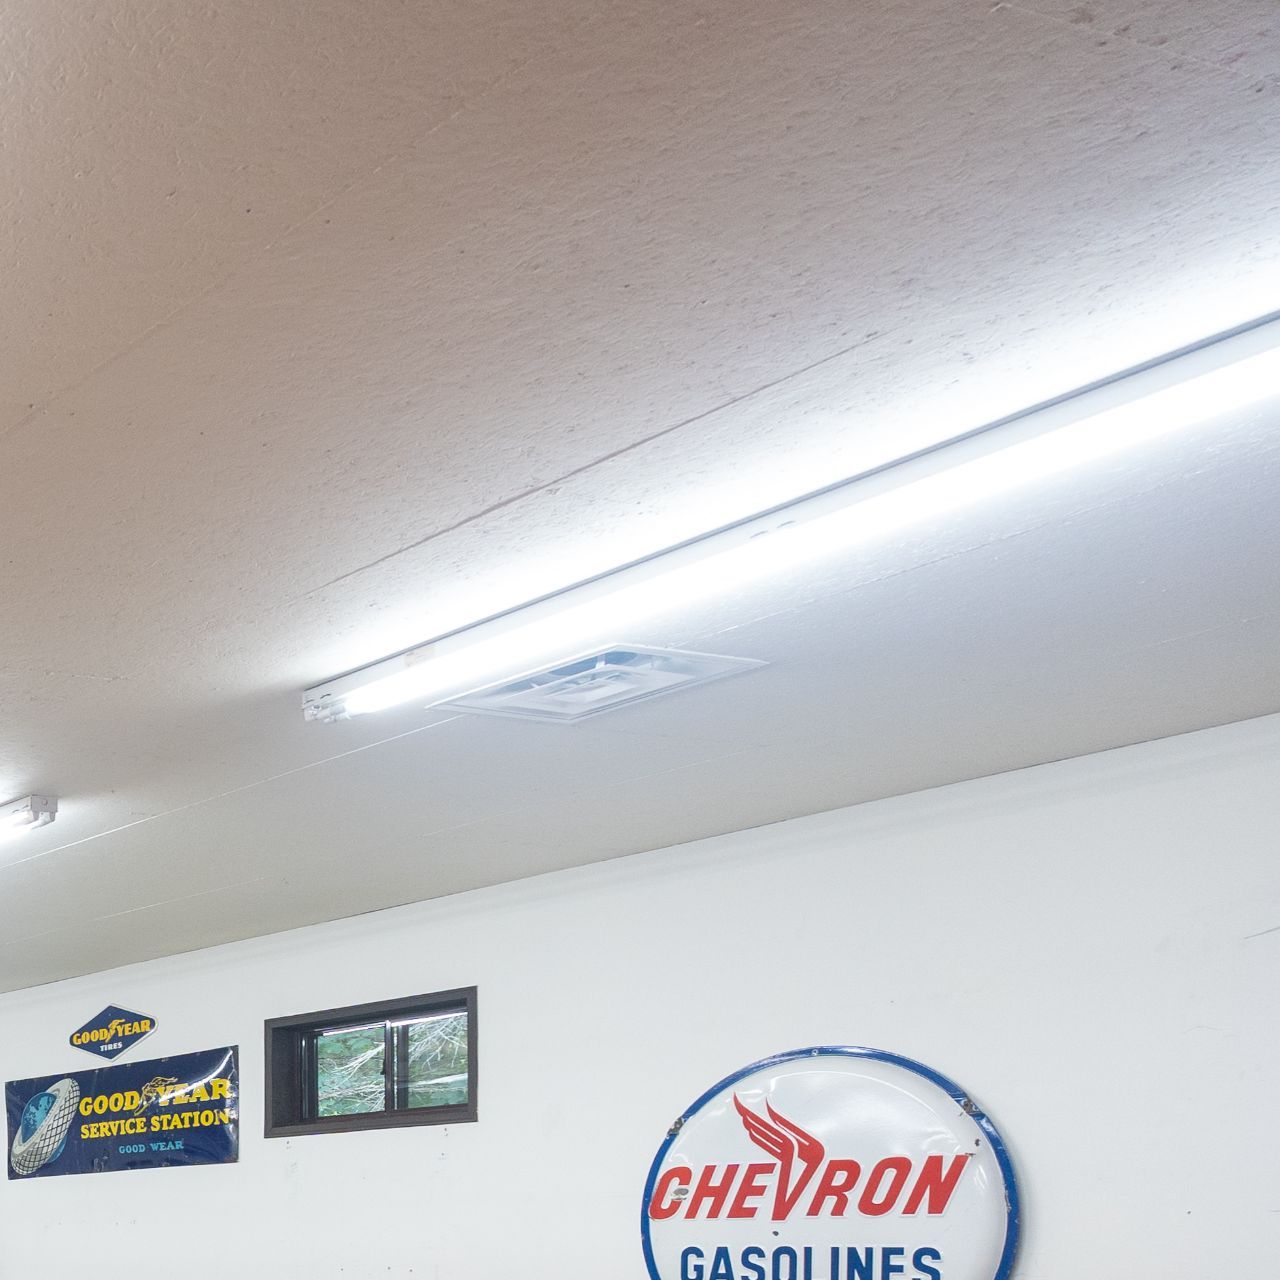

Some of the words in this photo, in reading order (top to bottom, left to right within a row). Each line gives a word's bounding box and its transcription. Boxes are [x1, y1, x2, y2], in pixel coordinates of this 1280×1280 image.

[100, 1041, 123, 1052] TIRES
[80, 1117, 147, 1140] SERVICE
[150, 1107, 231, 1132] STATION
[118, 1144, 146, 1154] GOOD
[149, 1140, 184, 1151] WEAR
[647, 1140, 969, 1222] CHEVRON
